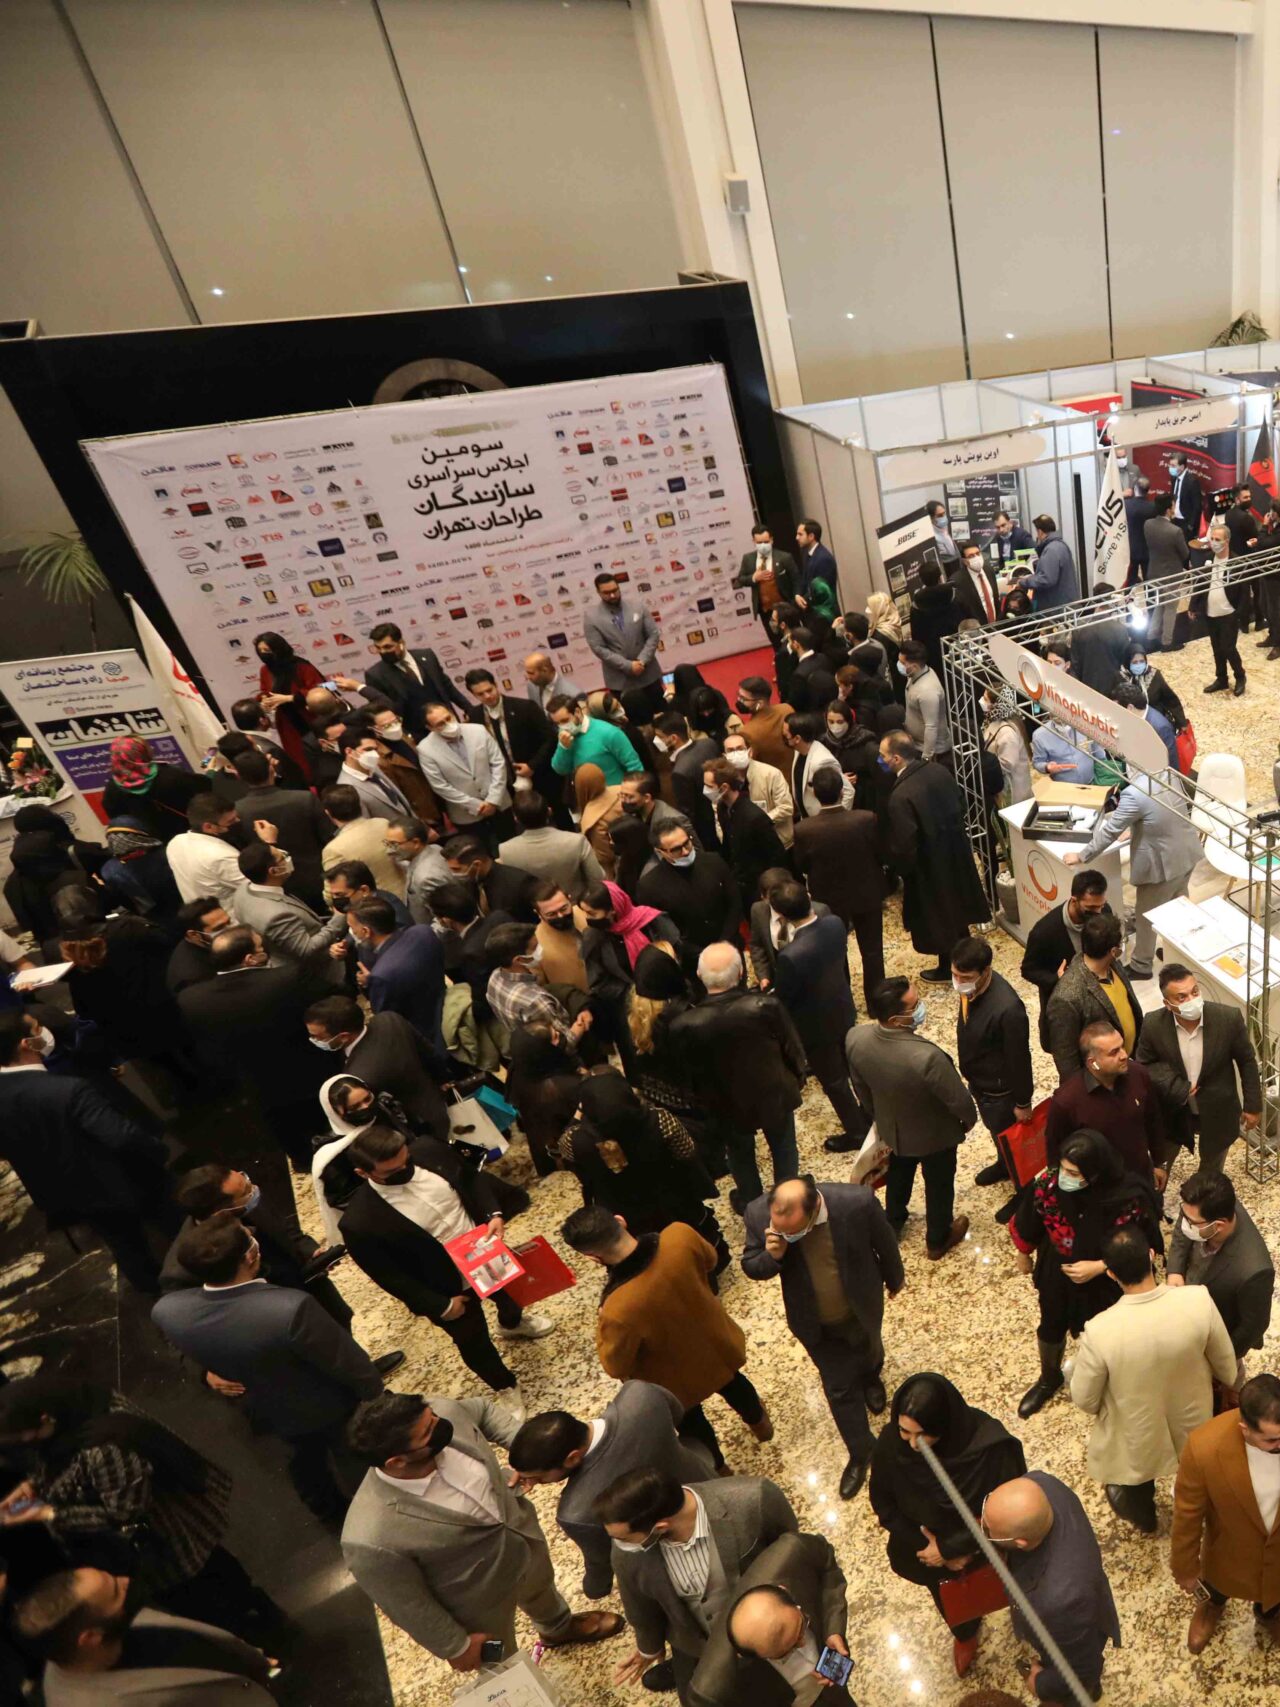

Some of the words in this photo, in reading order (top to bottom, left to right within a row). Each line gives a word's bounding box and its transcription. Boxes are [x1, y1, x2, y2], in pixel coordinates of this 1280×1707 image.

[421, 439, 504, 465] سومین
[407, 465, 477, 490] سراسری
[477, 453, 529, 478] اجلاس
[413, 479, 536, 516] سازندگان
[422, 516, 476, 541] تهران
[476, 504, 543, 531] طراحان
[58, 664, 95, 675] مجتمع
[22, 679, 81, 692] ساختمان
[45, 712, 169, 747] ساختمان
